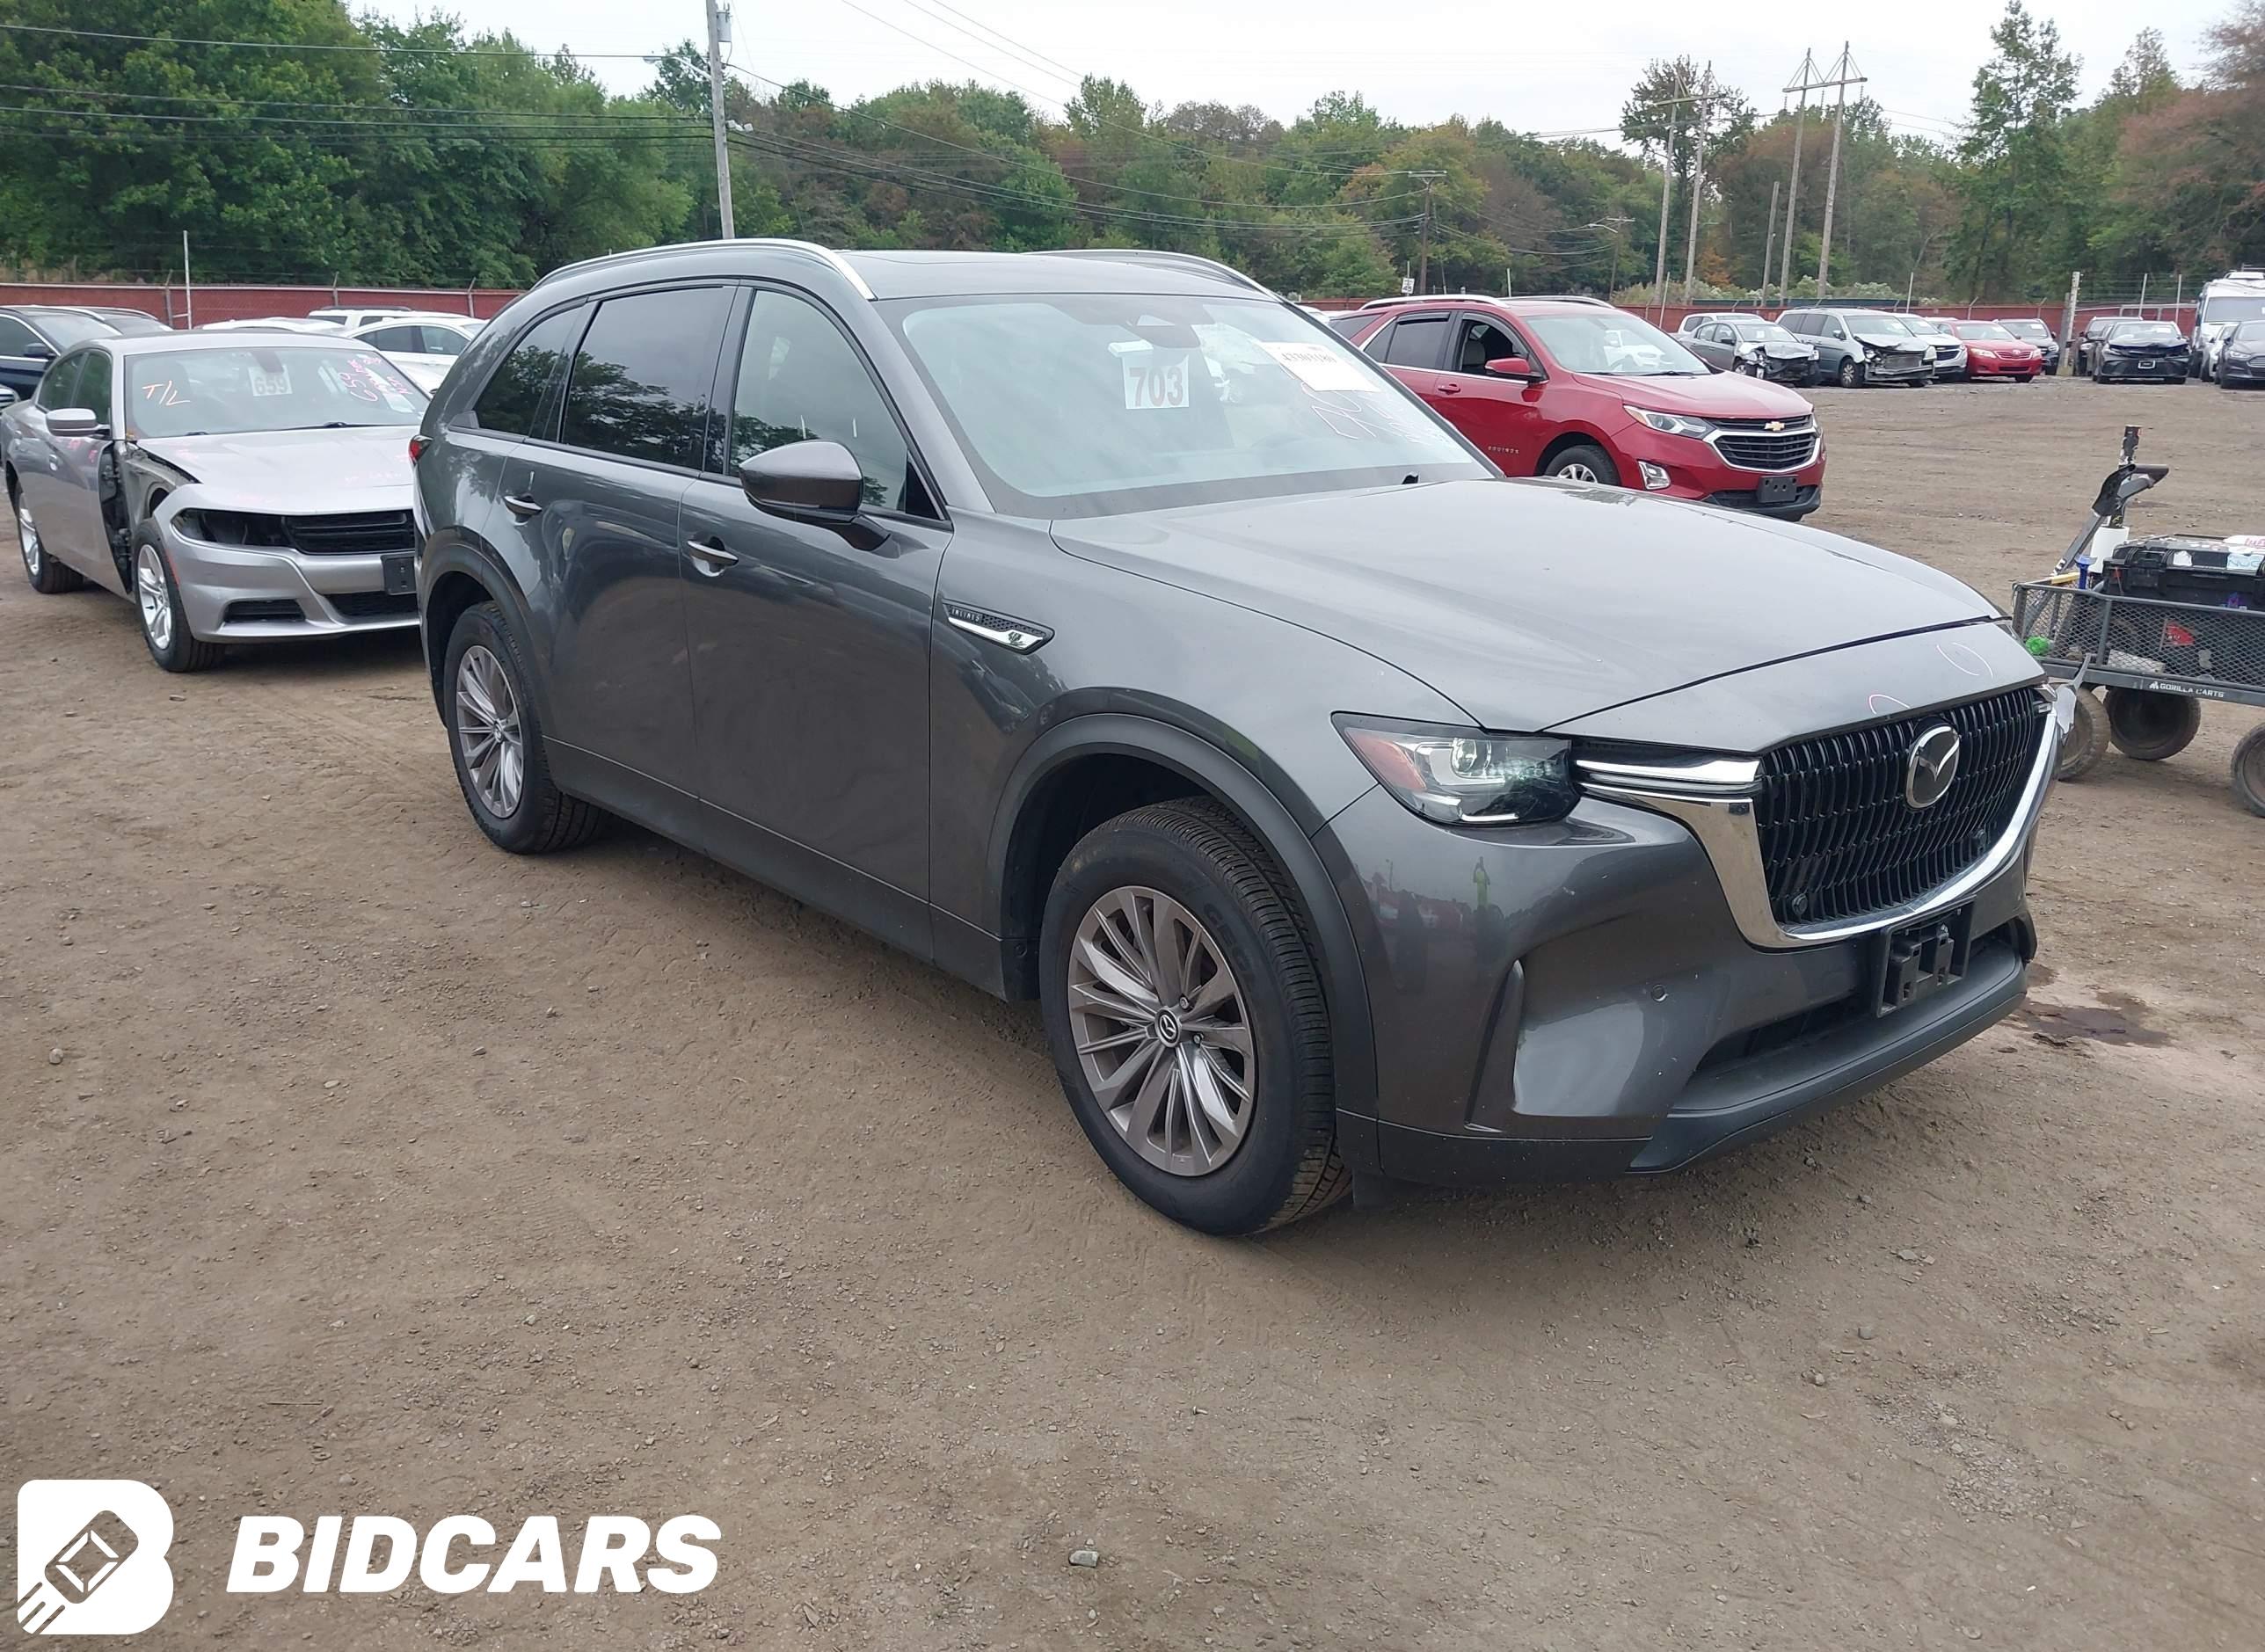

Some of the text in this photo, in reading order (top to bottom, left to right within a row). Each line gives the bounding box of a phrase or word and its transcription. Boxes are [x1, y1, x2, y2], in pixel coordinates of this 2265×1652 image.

[142, 380, 191, 406] T/L
[253, 375, 289, 395] 659
[1128, 367, 1183, 408] 703
[2159, 682, 2225, 698] GORILLA CARTS
